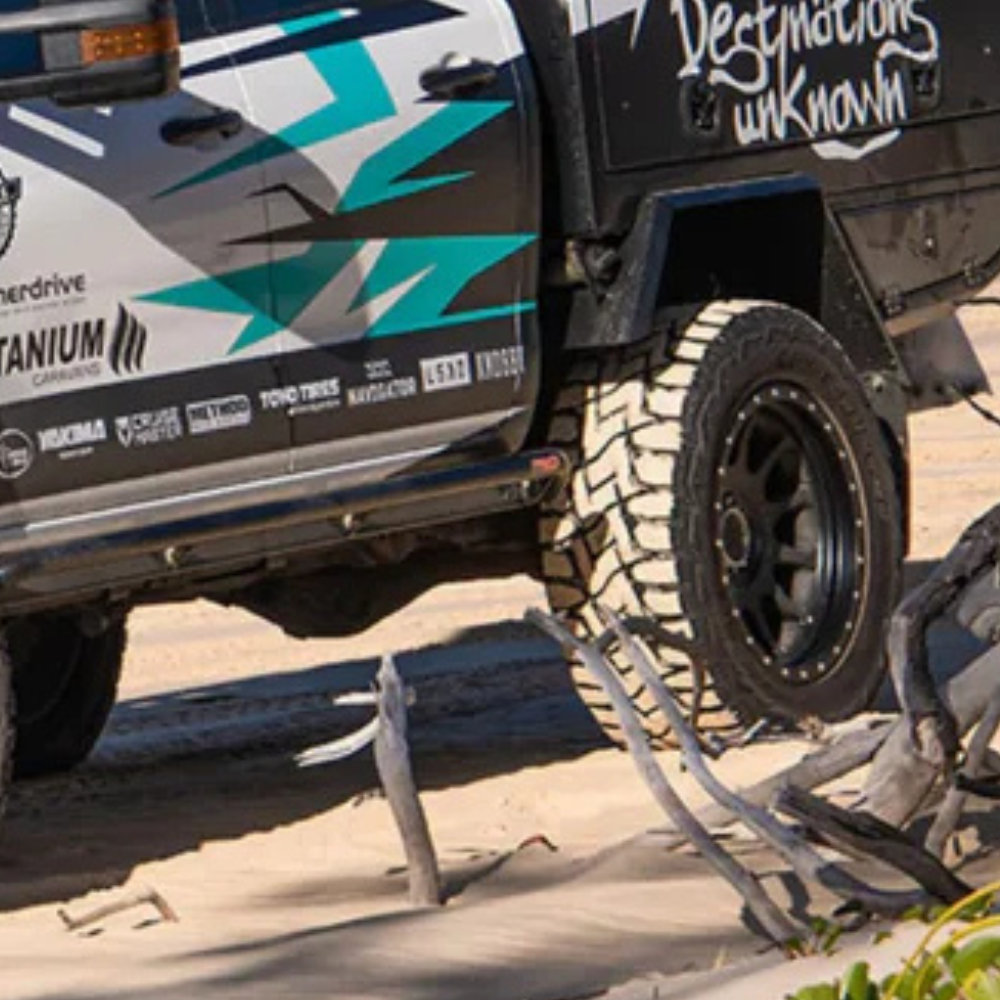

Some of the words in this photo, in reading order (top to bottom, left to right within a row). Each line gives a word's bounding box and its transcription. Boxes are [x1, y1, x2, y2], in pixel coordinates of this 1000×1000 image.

[259, 385, 298, 409] TOYO
[299, 377, 341, 401] TIRES
[37, 418, 107, 452] YAKIMA
